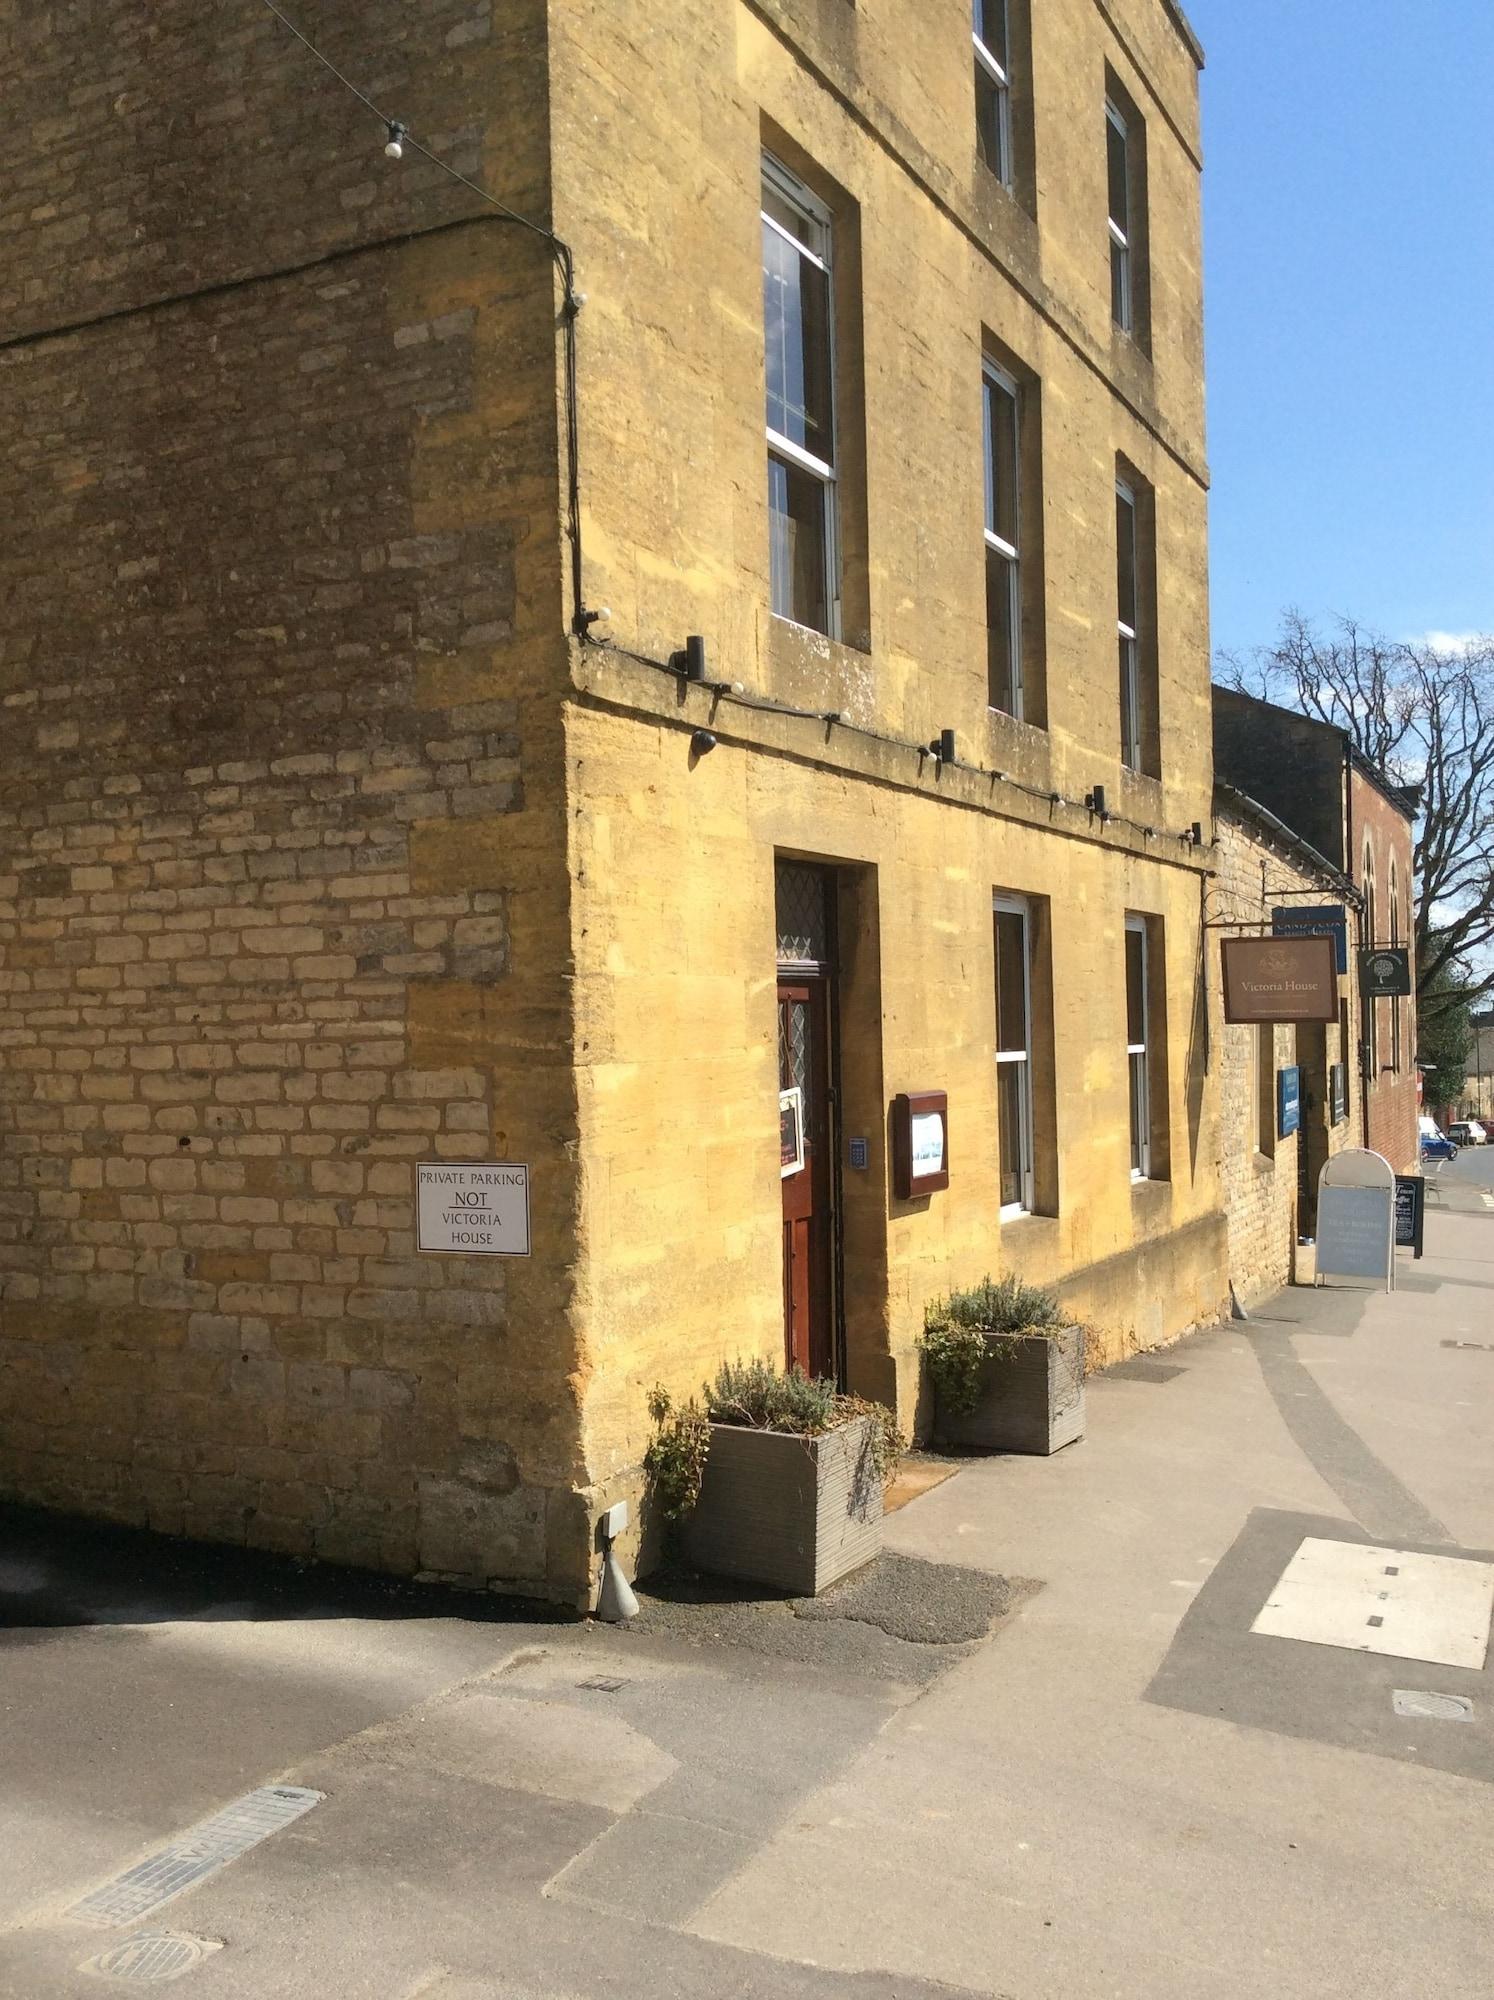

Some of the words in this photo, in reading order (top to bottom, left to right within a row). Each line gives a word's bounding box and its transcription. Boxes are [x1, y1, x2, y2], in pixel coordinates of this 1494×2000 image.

[1241, 981, 1282, 992] Victoria
[1285, 981, 1319, 991] House
[420, 1172, 465, 1185] PRIVATE
[471, 1173, 524, 1186] PARKING
[455, 1191, 488, 1206] NOT
[442, 1213, 502, 1226] VICTORIA
[451, 1232, 493, 1244] HOUSE
